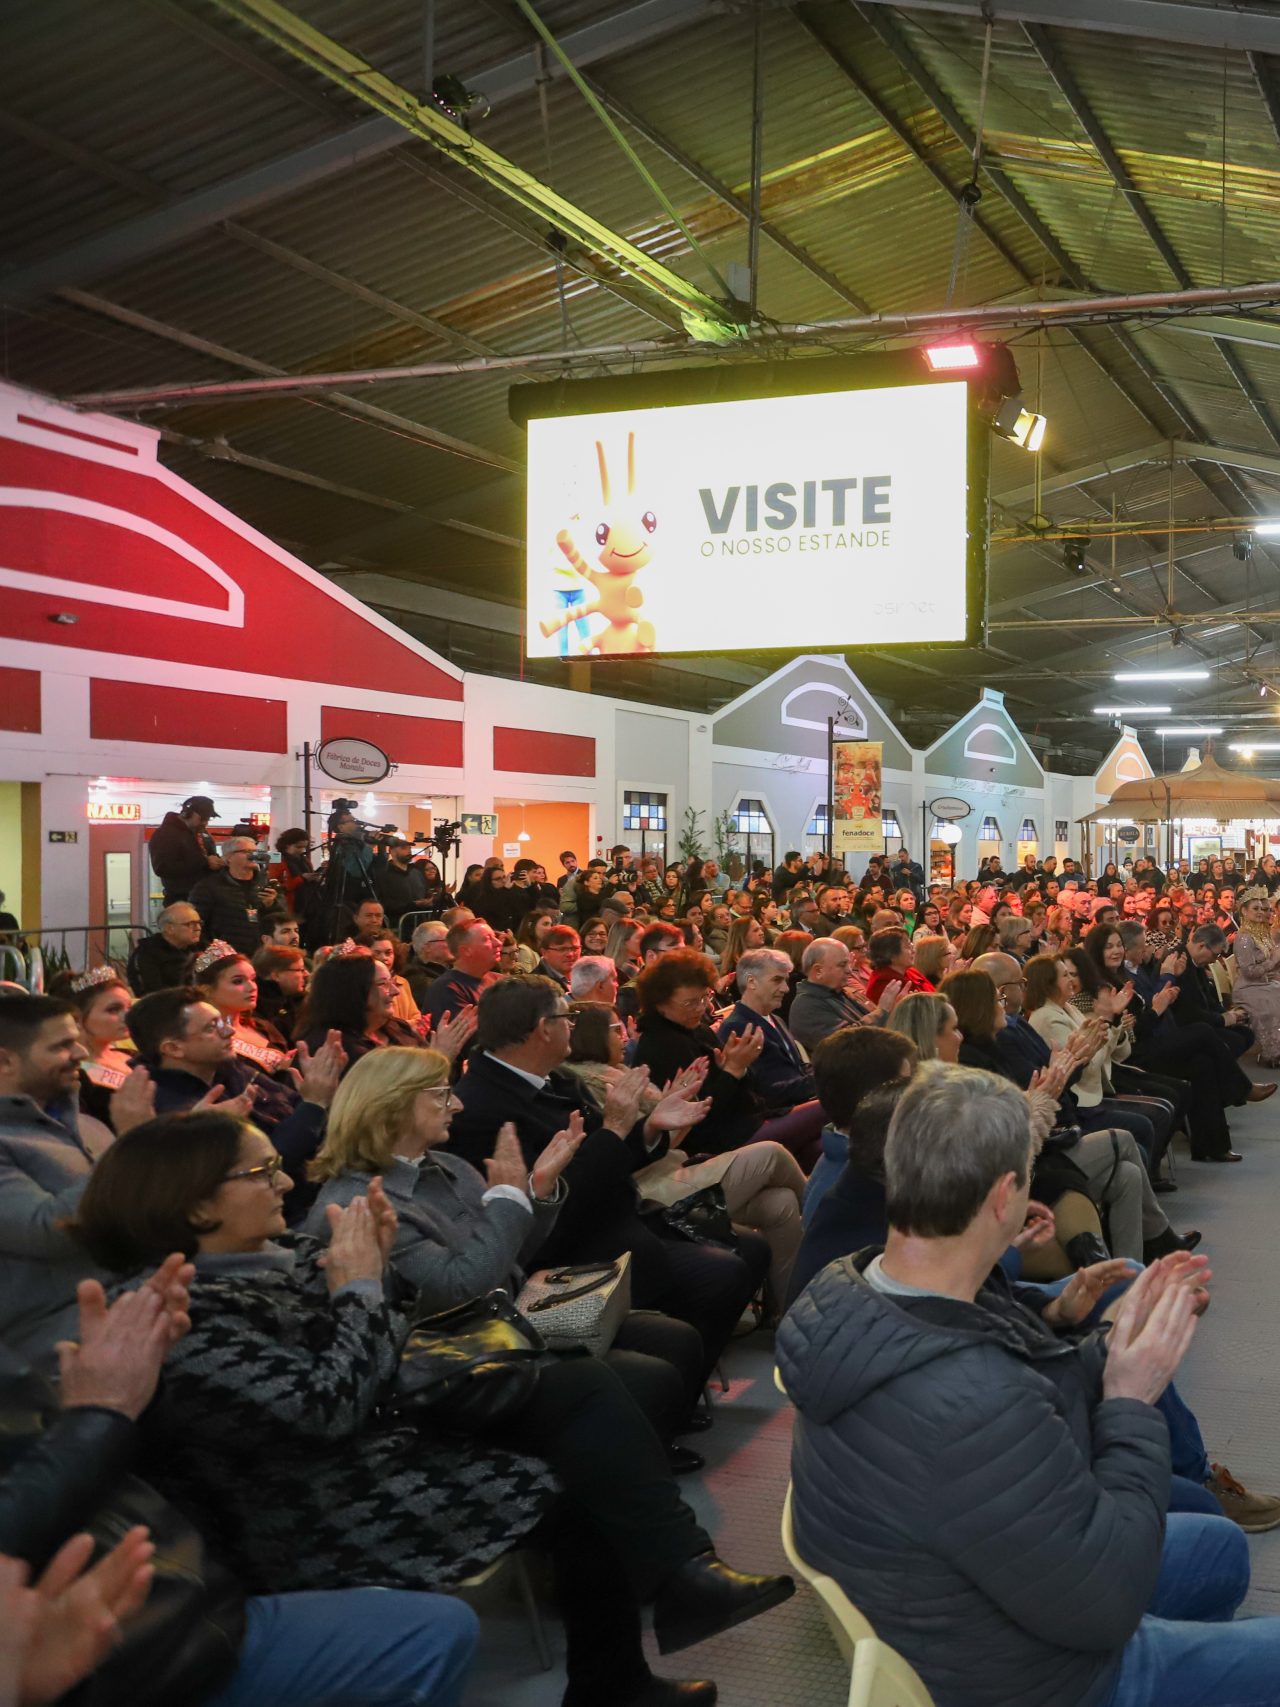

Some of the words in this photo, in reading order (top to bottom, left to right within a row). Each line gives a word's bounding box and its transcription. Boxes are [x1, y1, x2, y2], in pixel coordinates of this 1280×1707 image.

[698, 475, 892, 534] VISITE
[700, 541, 715, 557] O
[721, 536, 792, 556] NOSSO
[798, 530, 891, 551] ESTANDE
[87, 803, 135, 819] NALU
[842, 829, 875, 837] fenadoce
